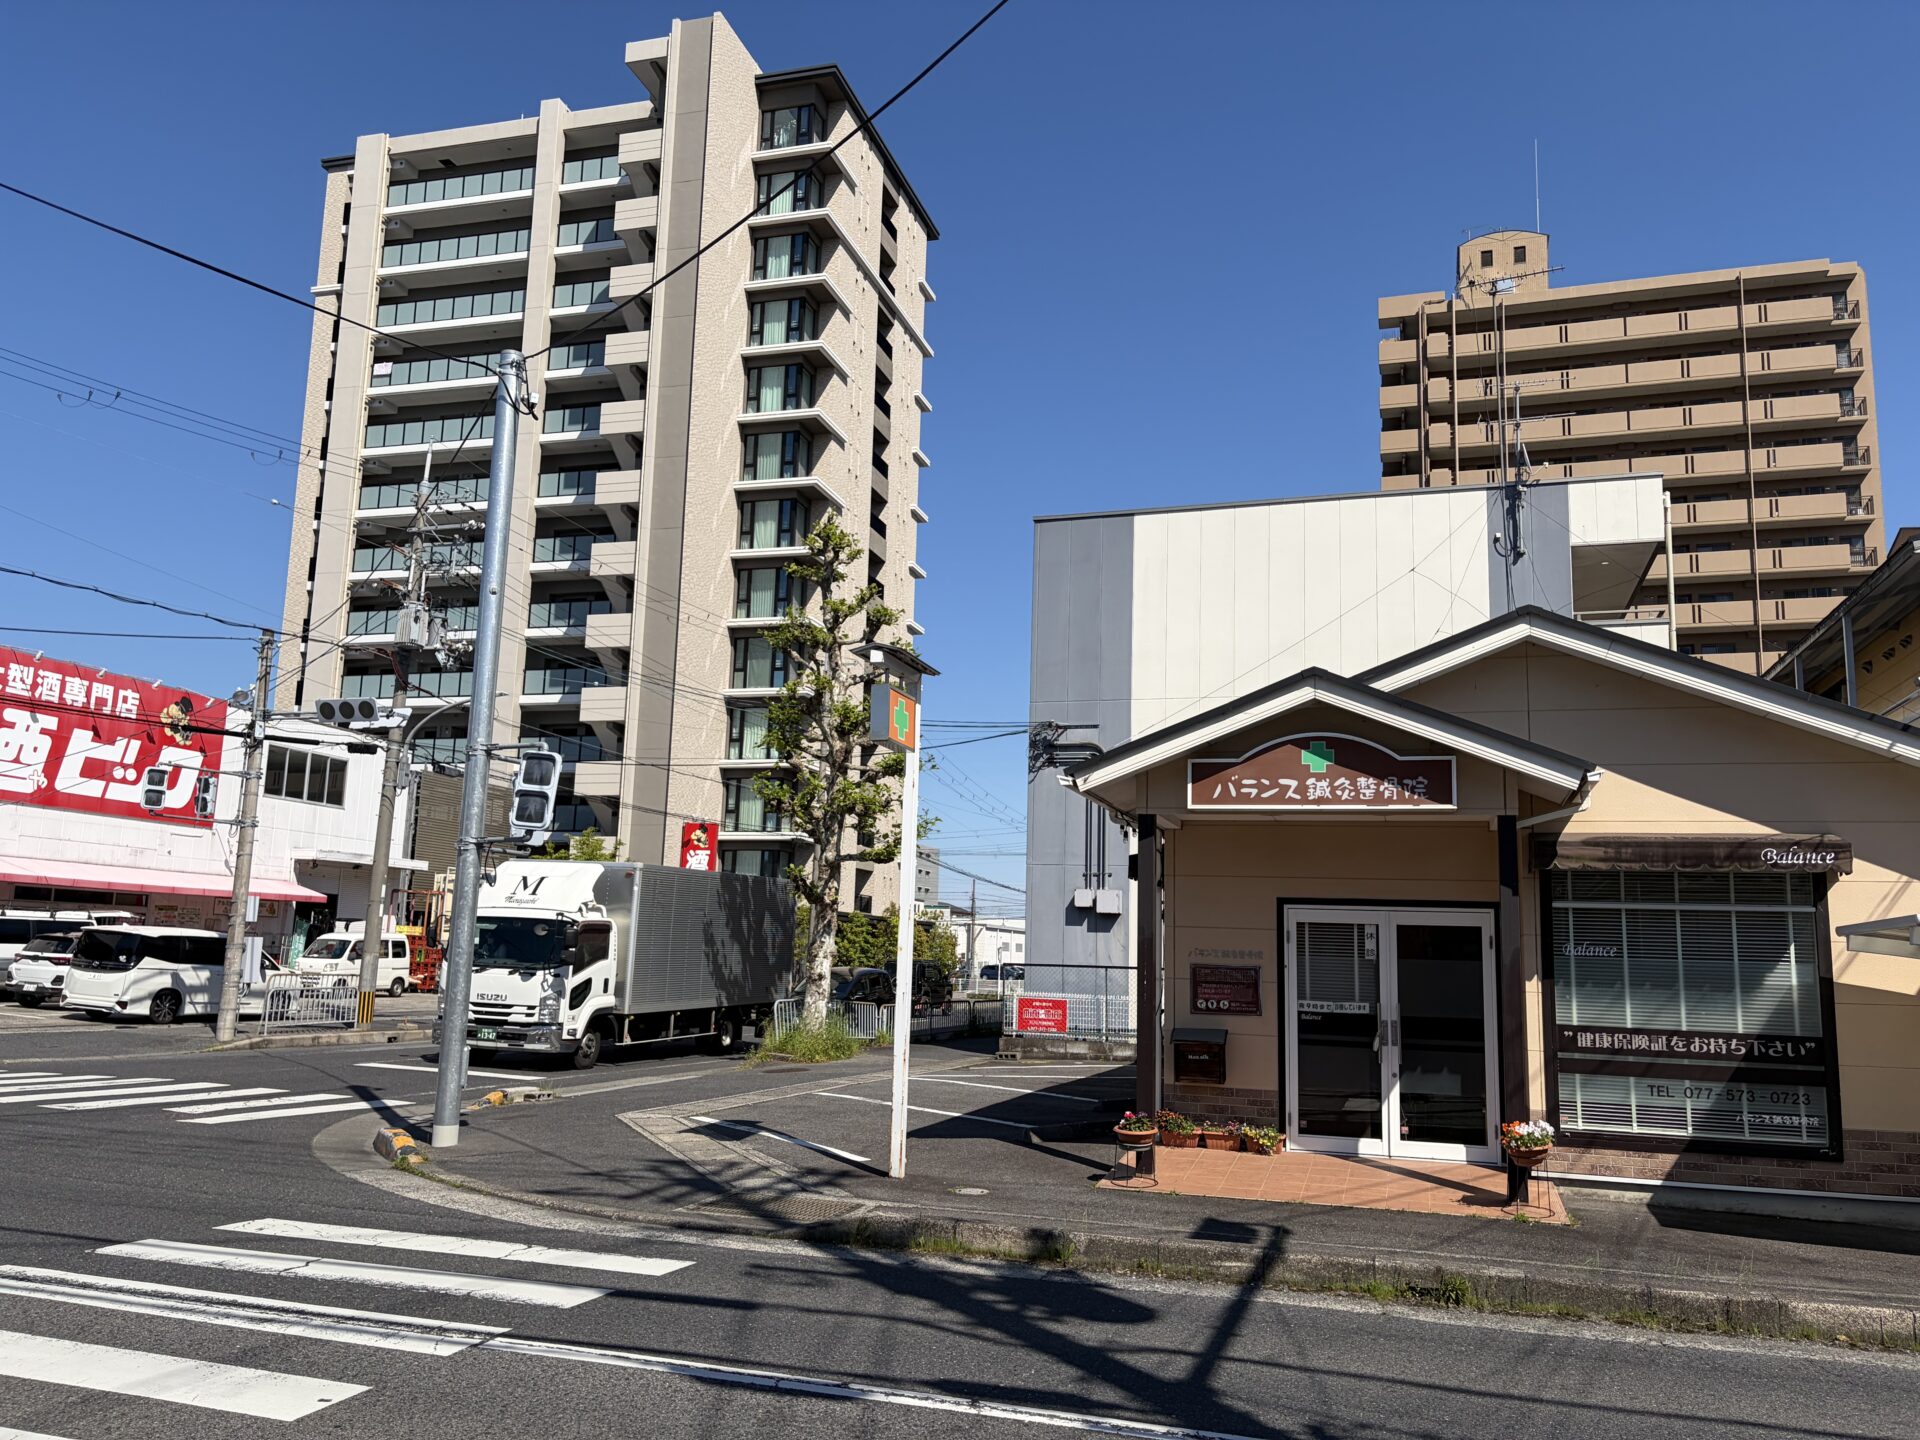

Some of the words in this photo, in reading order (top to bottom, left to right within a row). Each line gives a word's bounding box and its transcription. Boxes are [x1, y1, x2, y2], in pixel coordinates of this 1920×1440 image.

[0, 662, 140, 719] 型酒専門店
[1761, 846, 1835, 864] Balance
[510, 875, 549, 896] M
[1562, 941, 1617, 957] Balance
[476, 993, 508, 1002] ISUZU
[1647, 1085, 1675, 1098] TEL
[1684, 1086, 1812, 1105] 077-573-0723
